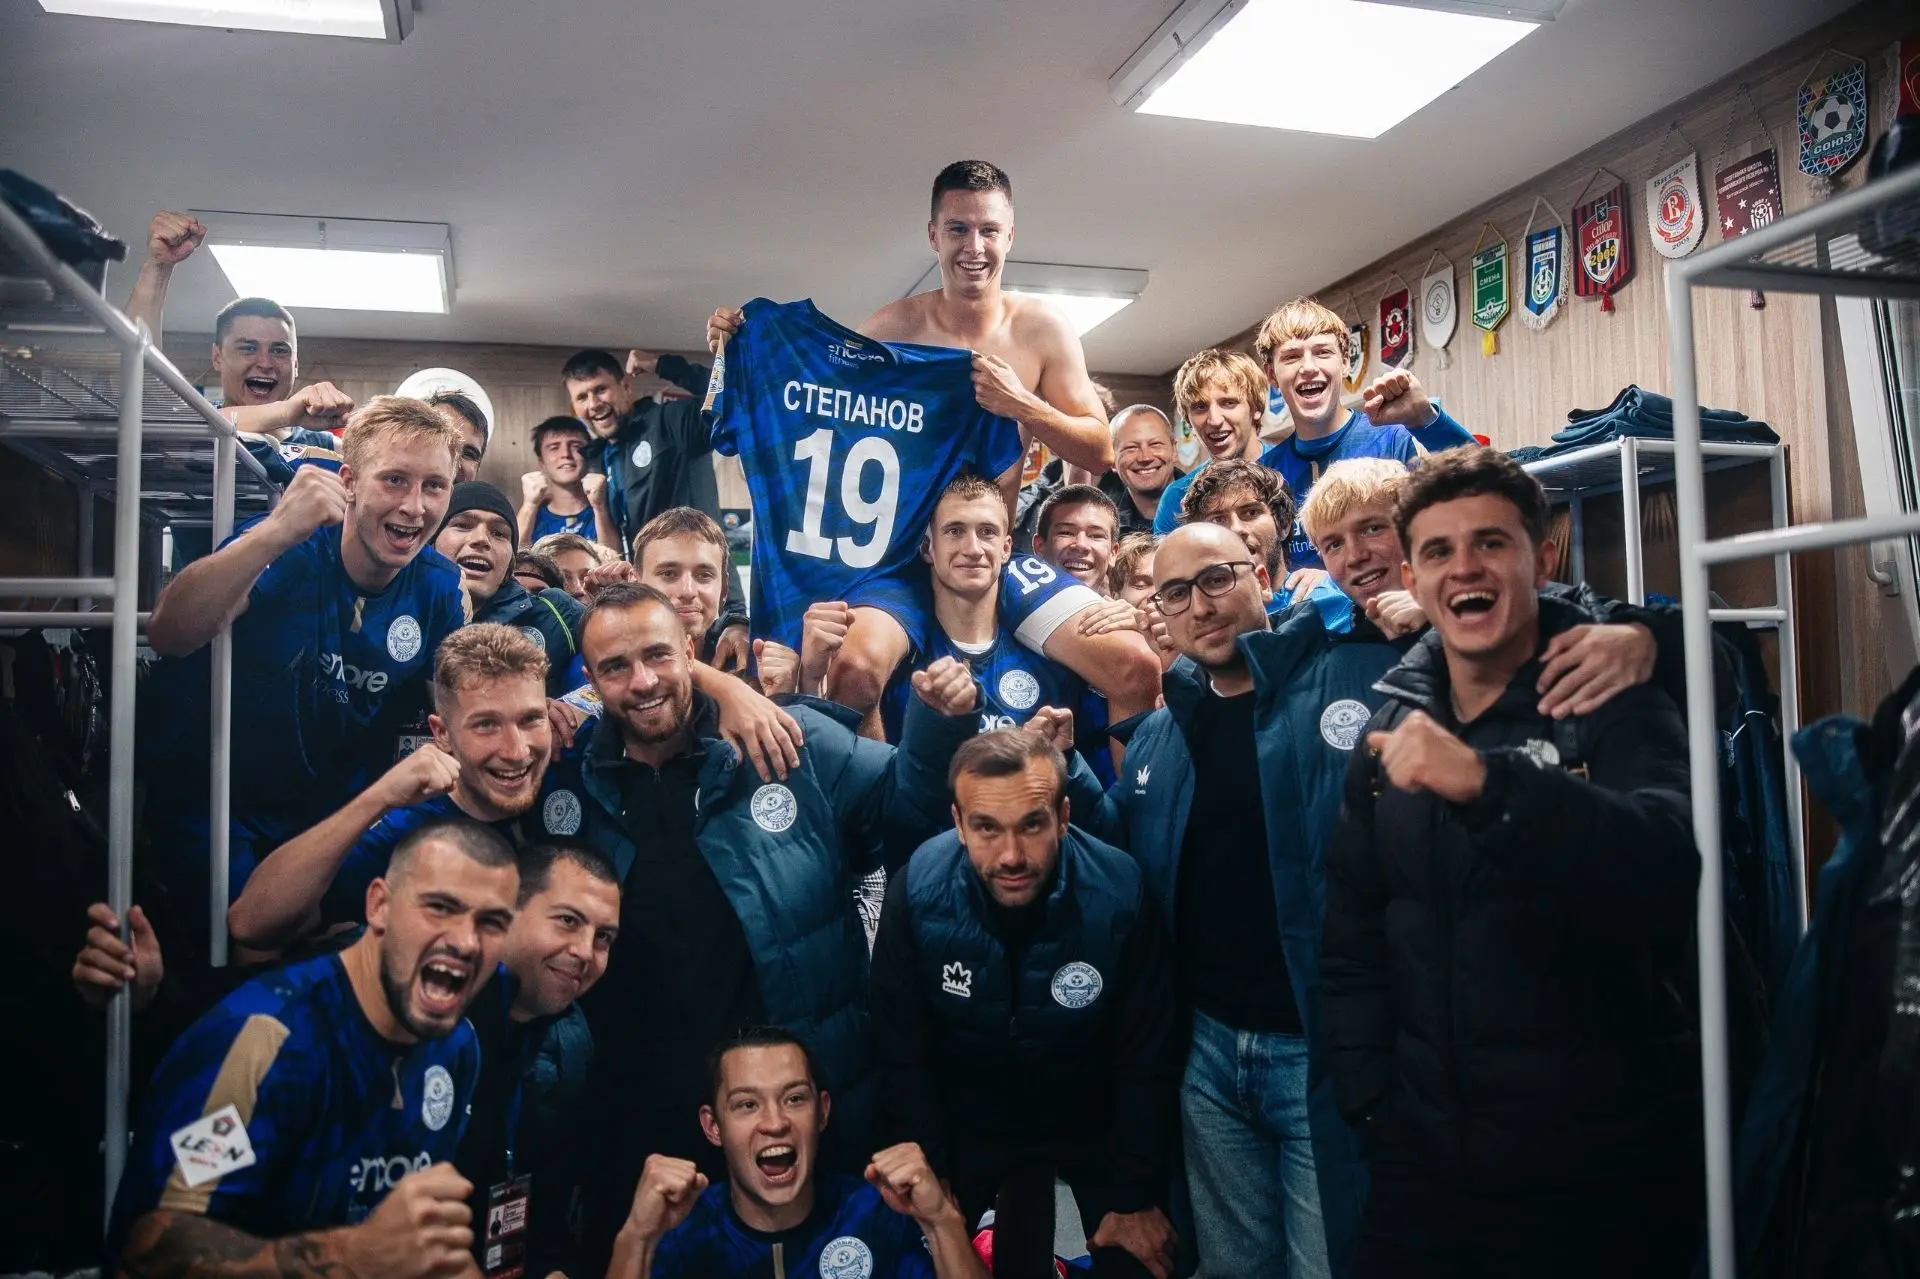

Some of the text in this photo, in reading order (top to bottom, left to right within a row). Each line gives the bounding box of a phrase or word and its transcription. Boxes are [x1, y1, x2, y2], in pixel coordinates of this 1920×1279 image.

[1813, 133, 1852, 154] СОЮЗ
[1589, 245, 1617, 267] 2008
[1480, 272, 1500, 286] СМЕНА
[783, 380, 924, 433] СТЕПАНОВ
[785, 428, 901, 569] 19
[1006, 557, 1058, 595] 19
